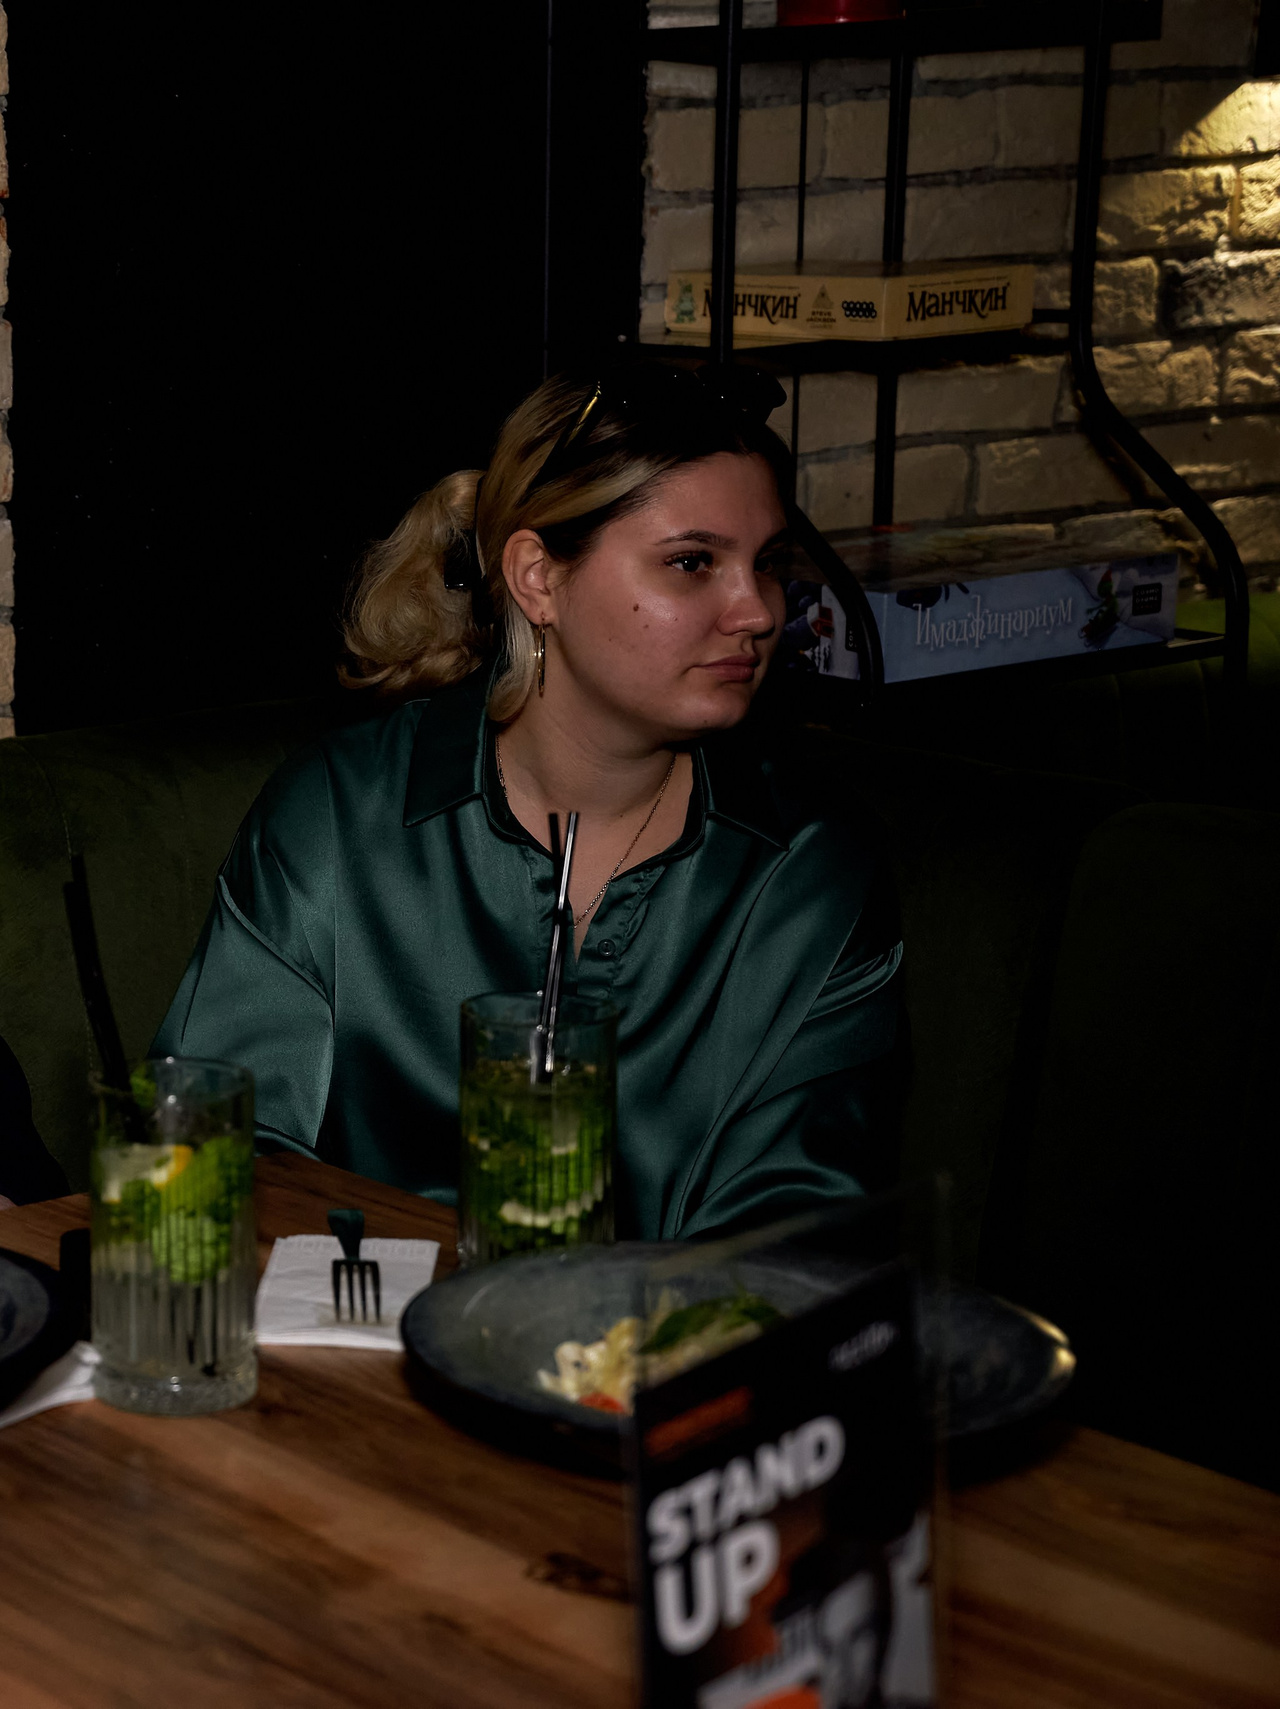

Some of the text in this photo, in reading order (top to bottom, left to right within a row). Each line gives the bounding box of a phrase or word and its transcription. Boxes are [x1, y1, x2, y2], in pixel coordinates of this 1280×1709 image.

[906, 286, 1008, 321] Манчкин
[913, 595, 1073, 651] Имаджинариум
[646, 1414, 846, 1566] STAND
[653, 1517, 781, 1657] UP
